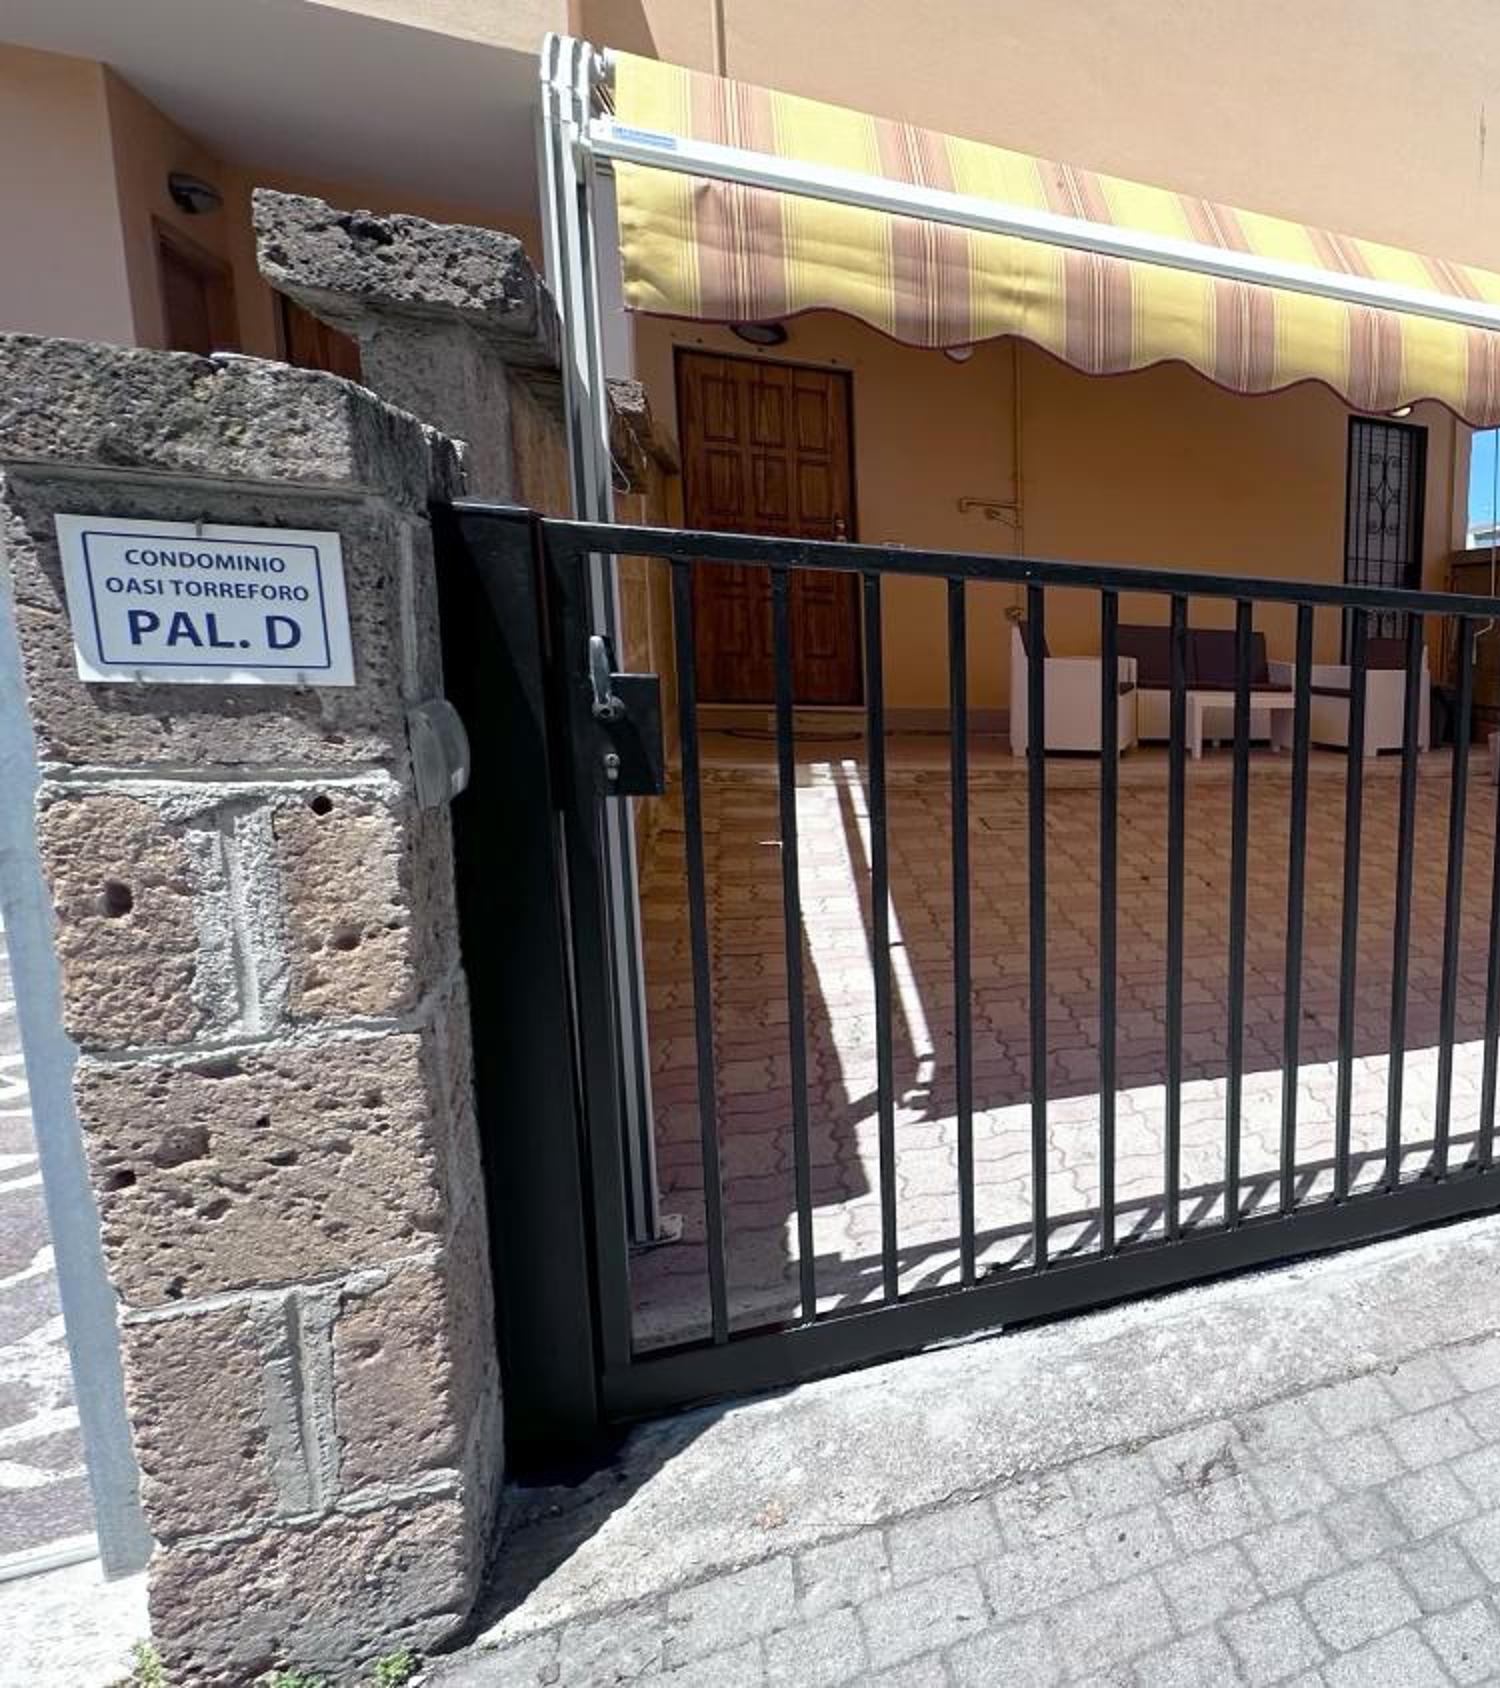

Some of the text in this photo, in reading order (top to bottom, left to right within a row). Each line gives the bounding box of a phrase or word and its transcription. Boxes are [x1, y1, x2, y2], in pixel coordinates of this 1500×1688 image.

[125, 549, 285, 573] CONDOMINIO
[105, 577, 309, 602] OASI TORREFORO
[127, 609, 302, 649] PAL. D
